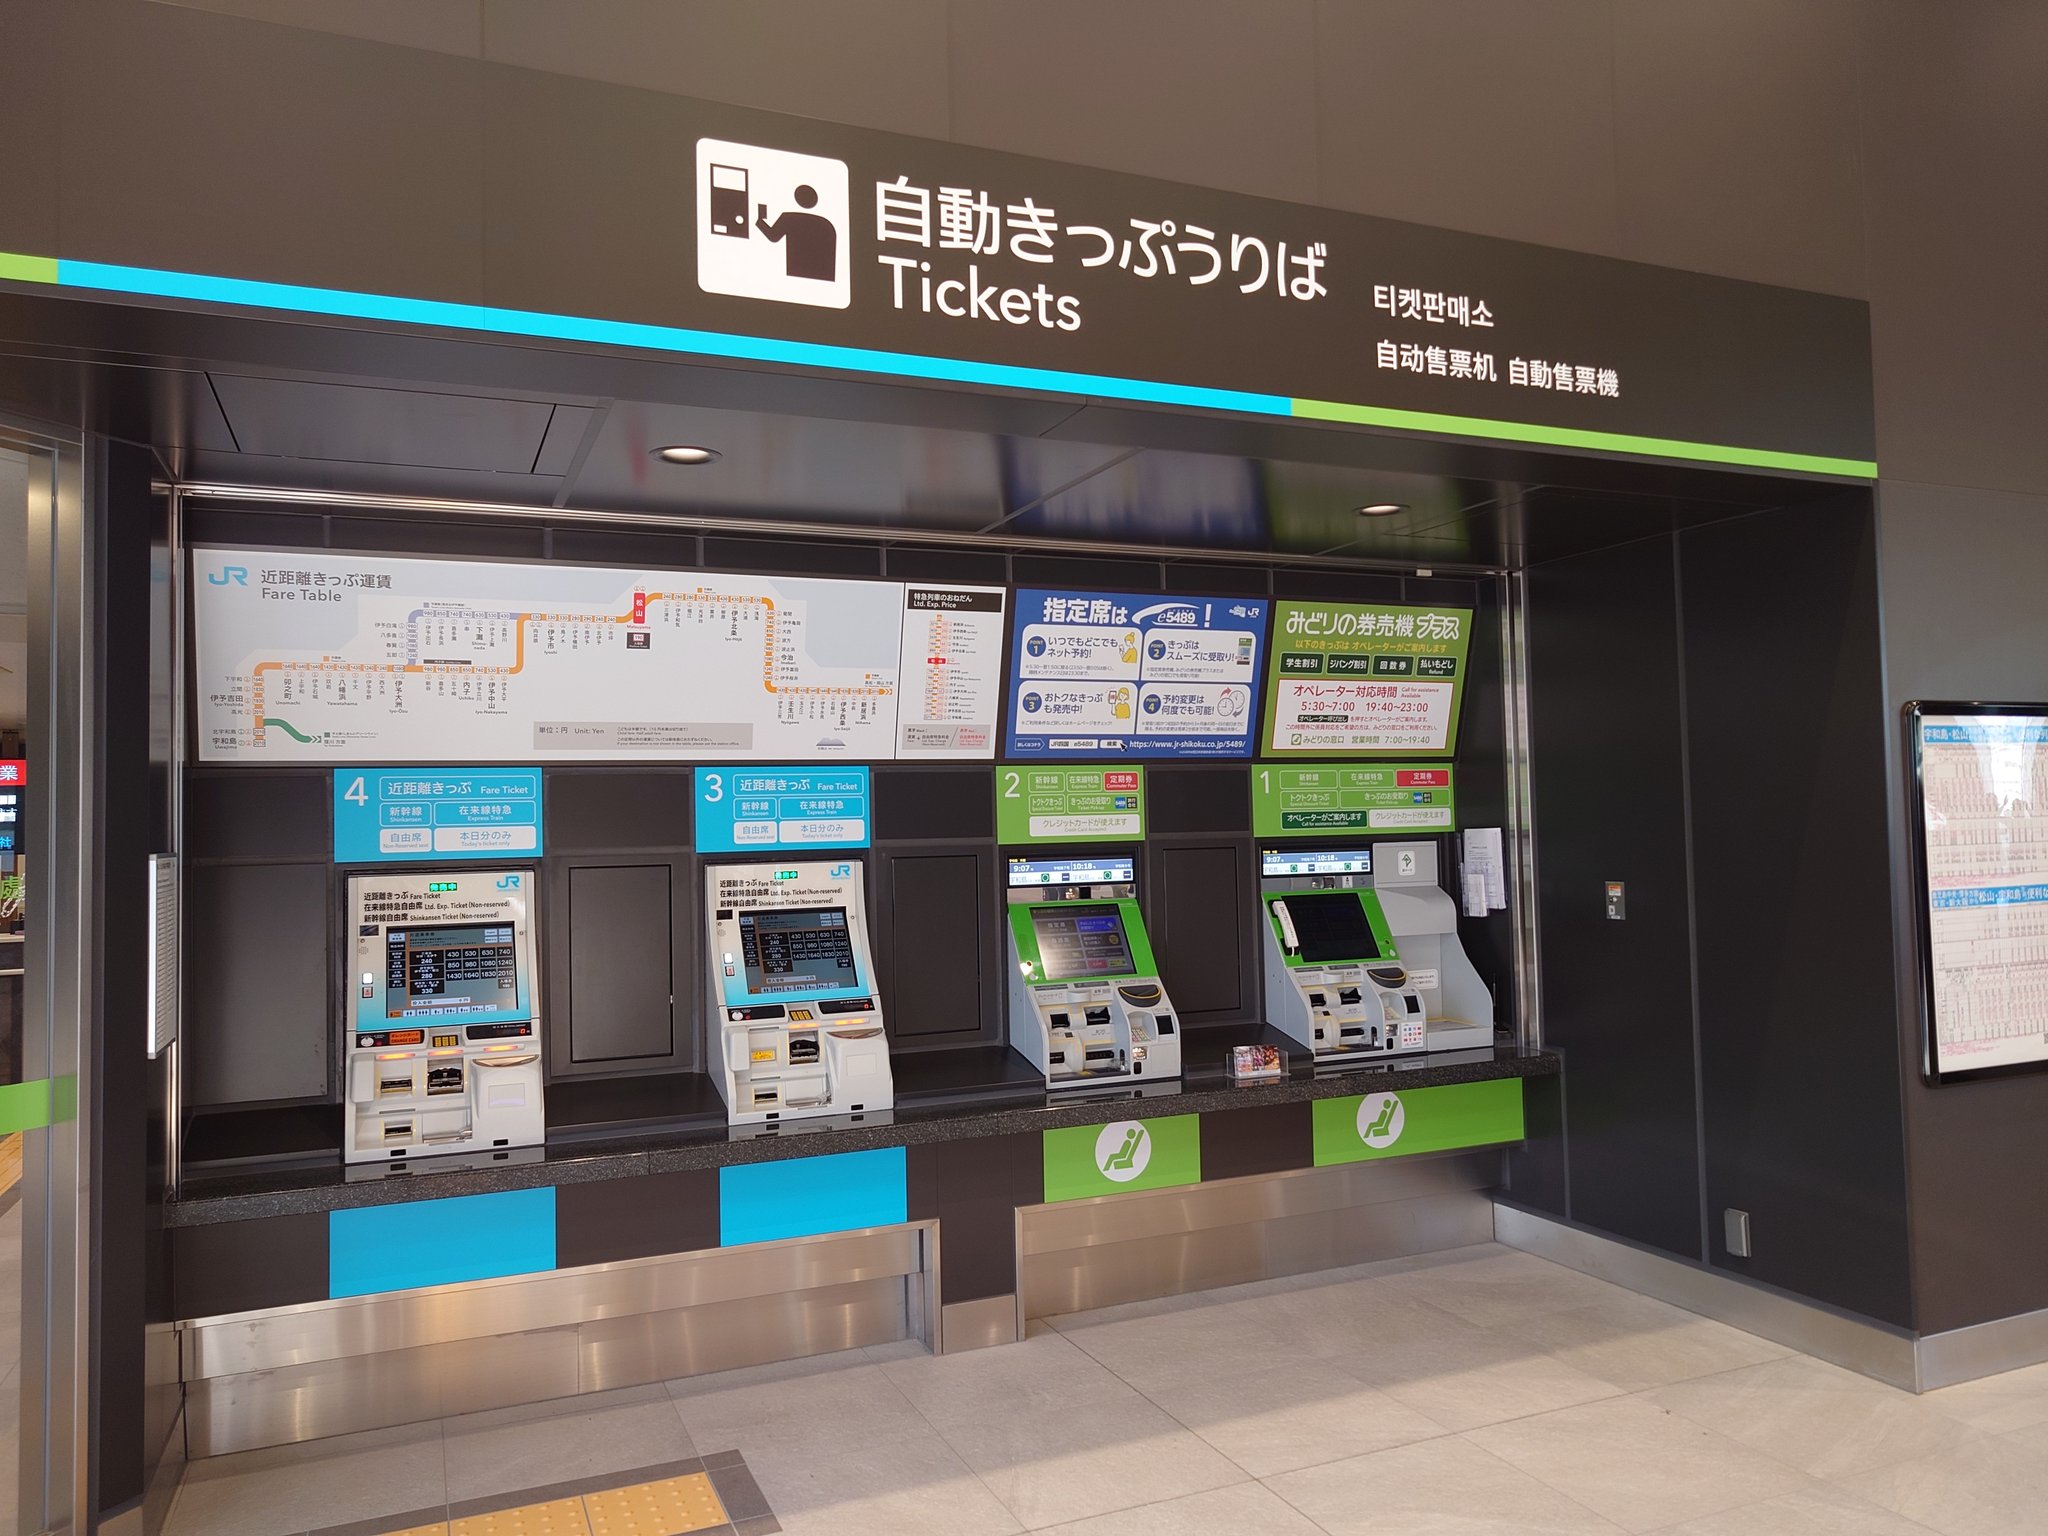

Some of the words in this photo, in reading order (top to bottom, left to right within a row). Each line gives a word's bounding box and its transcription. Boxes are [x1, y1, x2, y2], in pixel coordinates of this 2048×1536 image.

[875, 175, 1328, 301] 自動きっぷうりば
[877, 254, 1082, 332] Tickets
[1373, 284, 1494, 328] 티켓판매소
[1376, 339, 1497, 382] 自动售票机
[1508, 357, 1620, 397] 自動售票機
[208, 566, 248, 586] JR
[261, 569, 392, 589] 近距離きっぷ運賃
[261, 588, 295, 600] Fare
[300, 589, 342, 602] Table
[1043, 597, 1128, 625] 指定席は
[1157, 611, 1196, 624] e5489
[1247, 607, 1260, 616] JR
[1286, 611, 1414, 637] みどりの券売機
[1416, 613, 1460, 640] プラス
[1048, 637, 1118, 648] いつでもどこでも
[1168, 640, 1199, 650] きっぷは
[1295, 640, 1349, 650] 以下のきっぷは
[1153, 649, 1160, 657] 2
[1286, 658, 1318, 668] 学生割引
[1329, 658, 1367, 669] ジパング割引
[1420, 659, 1454, 669] 払いもどし
[1293, 685, 1397, 698] オペレーター対応時間
[1045, 693, 1103, 702] おトクなきっぷ
[1162, 694, 1204, 704] 予約変更は
[1029, 701, 1035, 710] 3
[1148, 703, 1155, 712] 4
[1129, 740, 1246, 749] https://www.jr-shikoku.co.jp/5489/
[1303, 736, 1344, 744] みどりの窓口
[1351, 736, 1379, 744] 営業時間
[740, 779, 810, 792] 近距離きっぷ
[817, 783, 834, 791] Fare
[1004, 772, 1020, 798] 2
[1260, 770, 1270, 794] 1
[344, 776, 369, 807] 4
[388, 781, 472, 795] 近距離きっぷ
[480, 786, 500, 794] Fare
[502, 785, 528, 794] Ticket
[704, 773, 723, 802] 3
[459, 805, 512, 815] 在来線特急
[741, 802, 769, 811] 新幹線
[800, 801, 844, 810] 在来線特急
[389, 807, 422, 816] 新幹線
[1287, 813, 1362, 822] オペレーターがご案内します
[743, 825, 769, 834] 自由席
[800, 824, 844, 833] 本日分のみ
[391, 832, 422, 842] 自由席
[460, 832, 511, 841] 本日分のみ
[830, 864, 850, 876] JR
[496, 875, 520, 889] JR
[364, 891, 409, 901] 近距離きっぷ
[364, 902, 423, 911] 在来線特急自由席
[437, 903, 450, 911] Exp.
[364, 912, 409, 922] 新幹線自由席
[459, 911, 499, 919] (Non-reserved)
